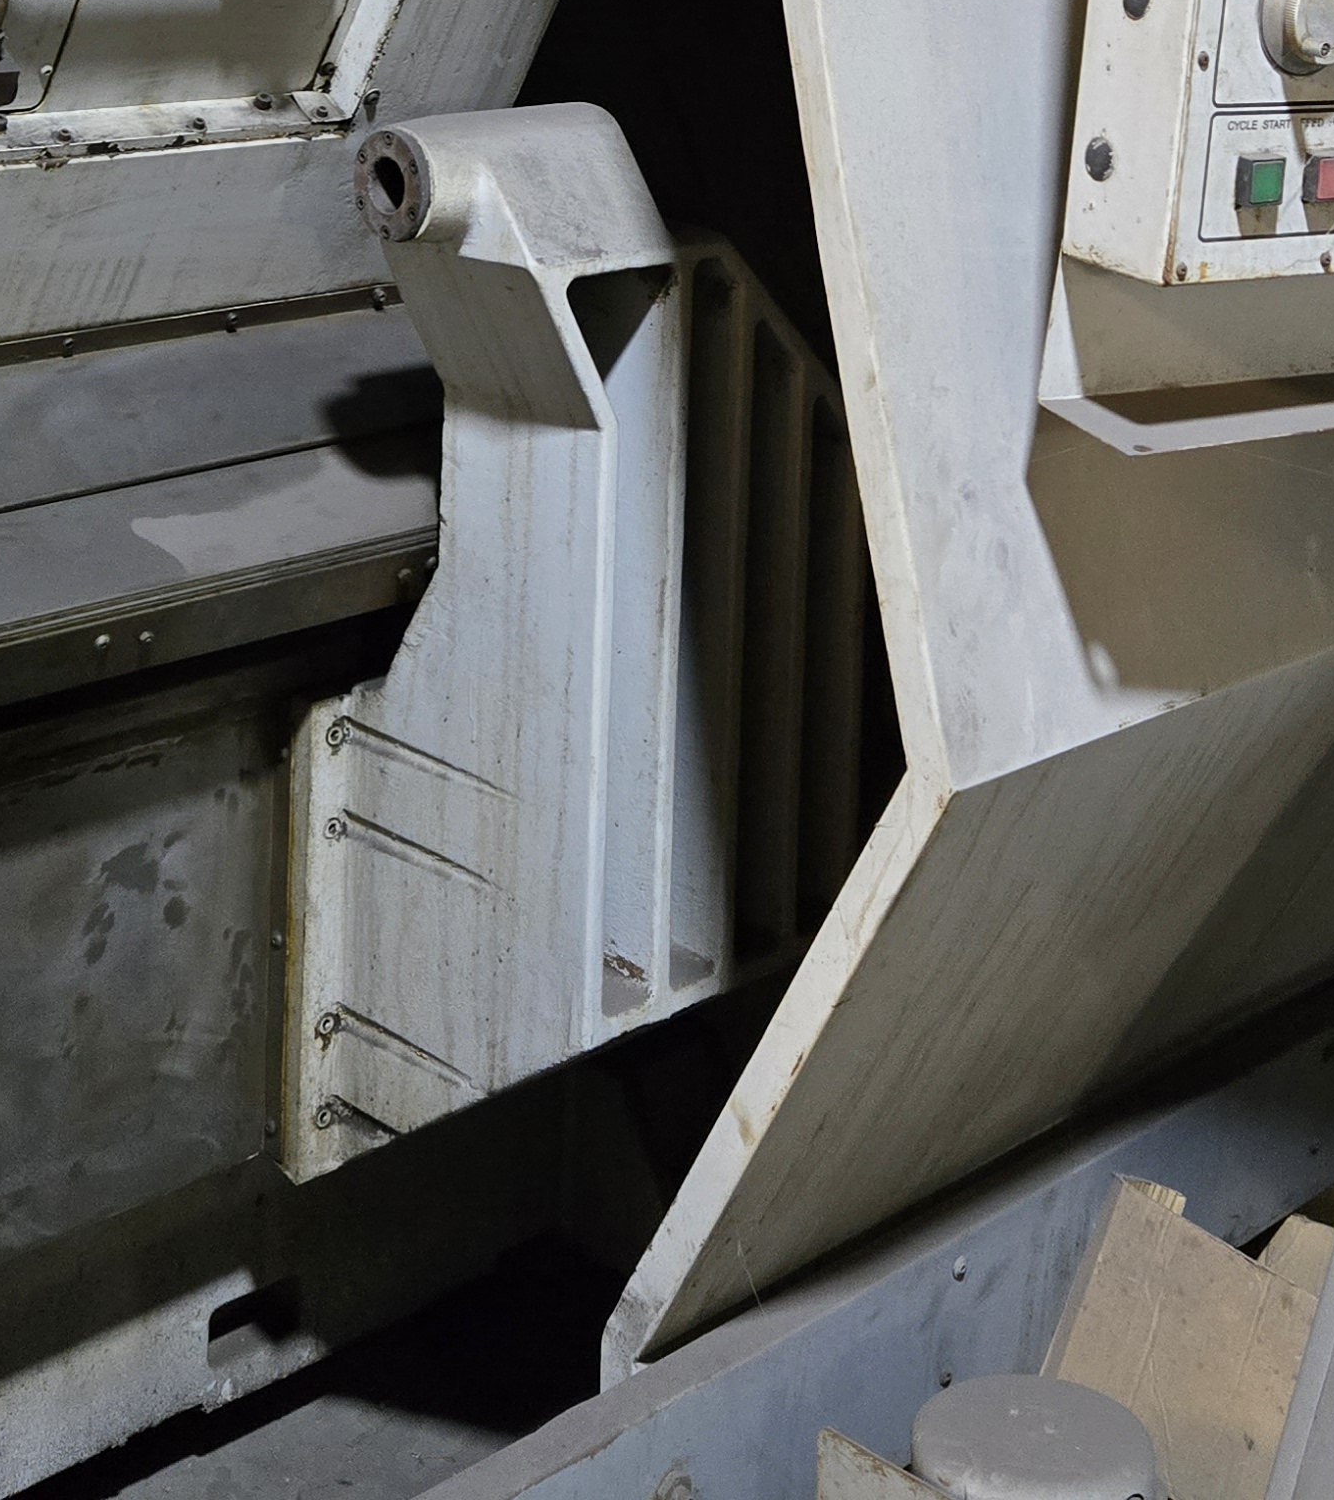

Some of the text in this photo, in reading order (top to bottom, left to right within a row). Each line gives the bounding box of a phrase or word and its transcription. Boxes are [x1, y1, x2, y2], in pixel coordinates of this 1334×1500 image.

[1228, 120, 1291, 131] CYCLE START
[1300, 117, 1325, 127] FEED
